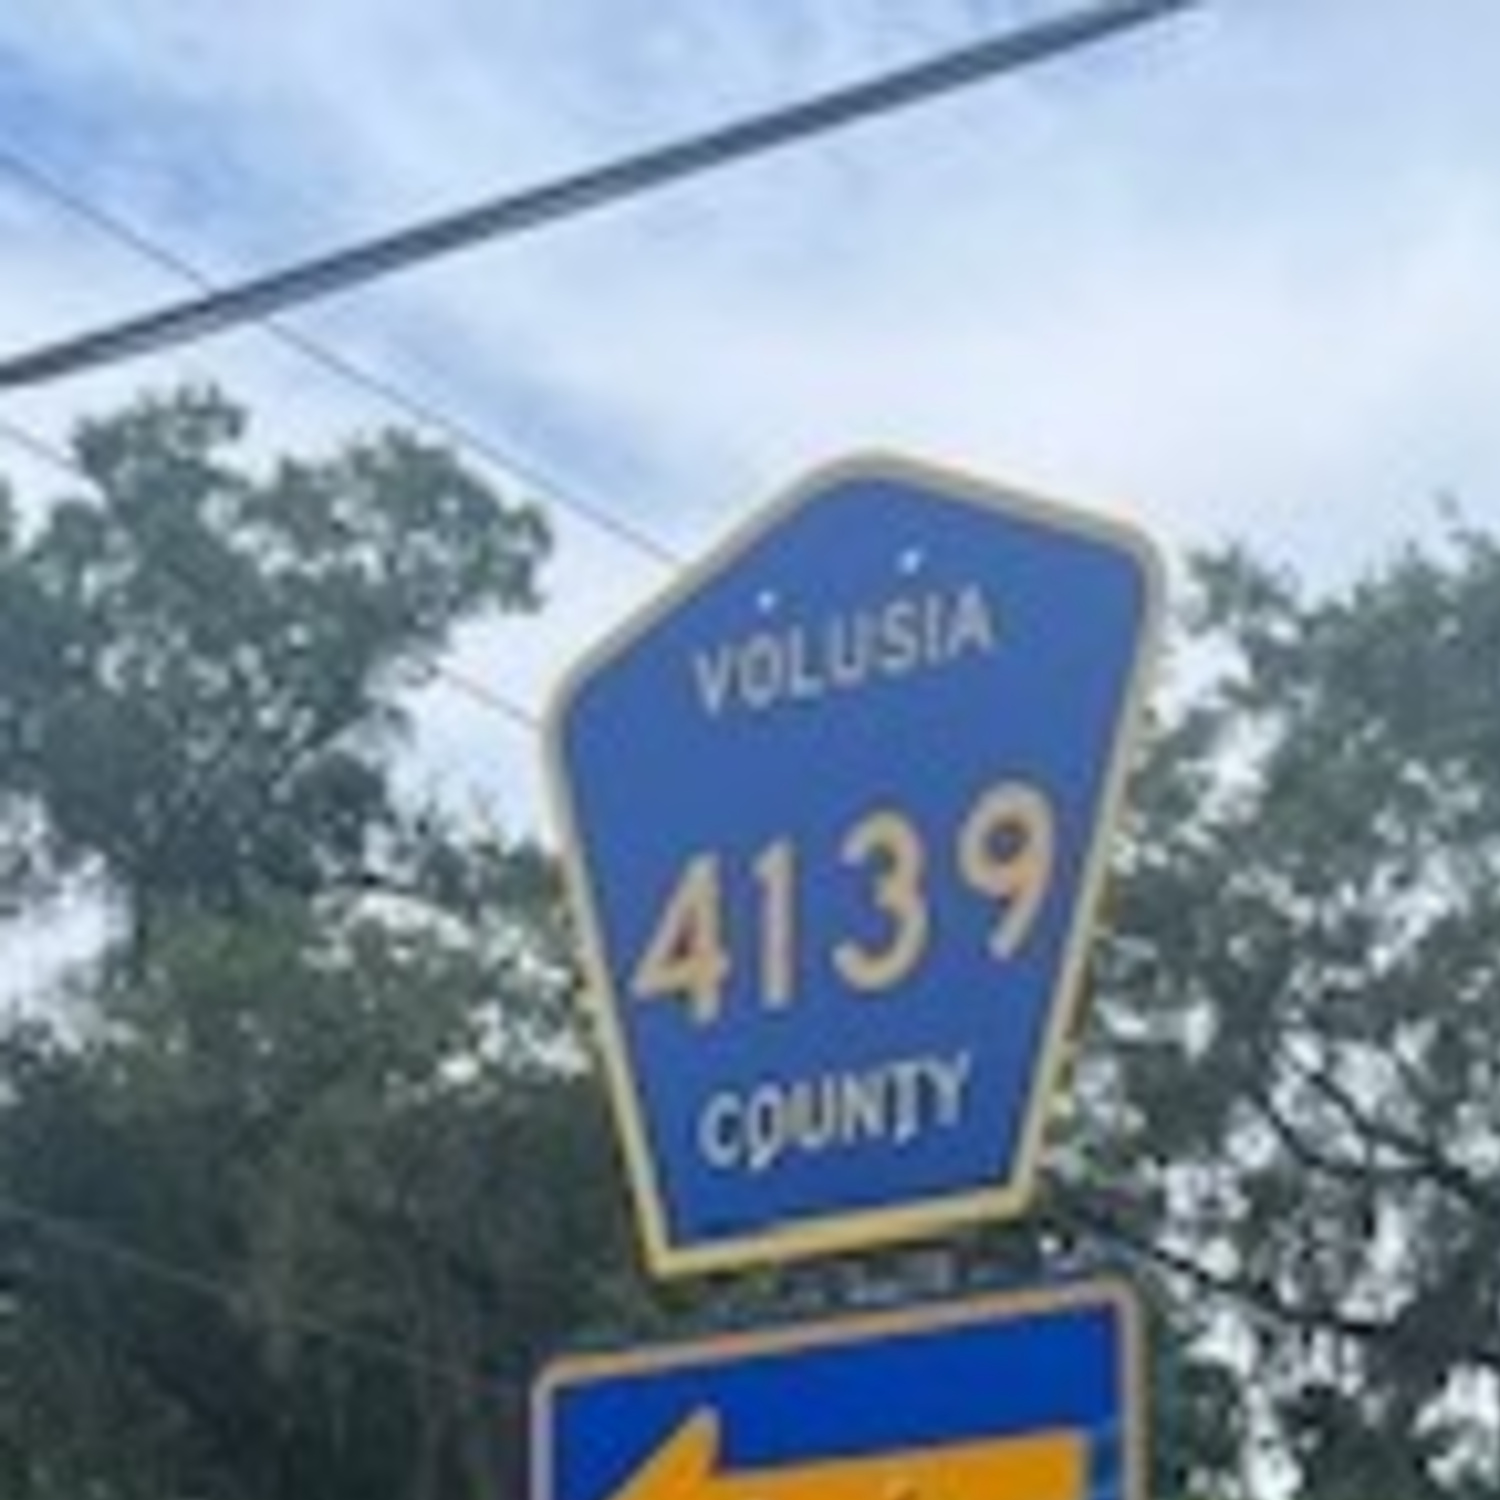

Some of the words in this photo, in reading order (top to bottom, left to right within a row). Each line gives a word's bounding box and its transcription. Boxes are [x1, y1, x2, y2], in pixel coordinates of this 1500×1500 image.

[694, 585, 992, 713] VOLUSIA
[634, 784, 1055, 1023] 4139
[699, 1054, 970, 1171] COUNTY
